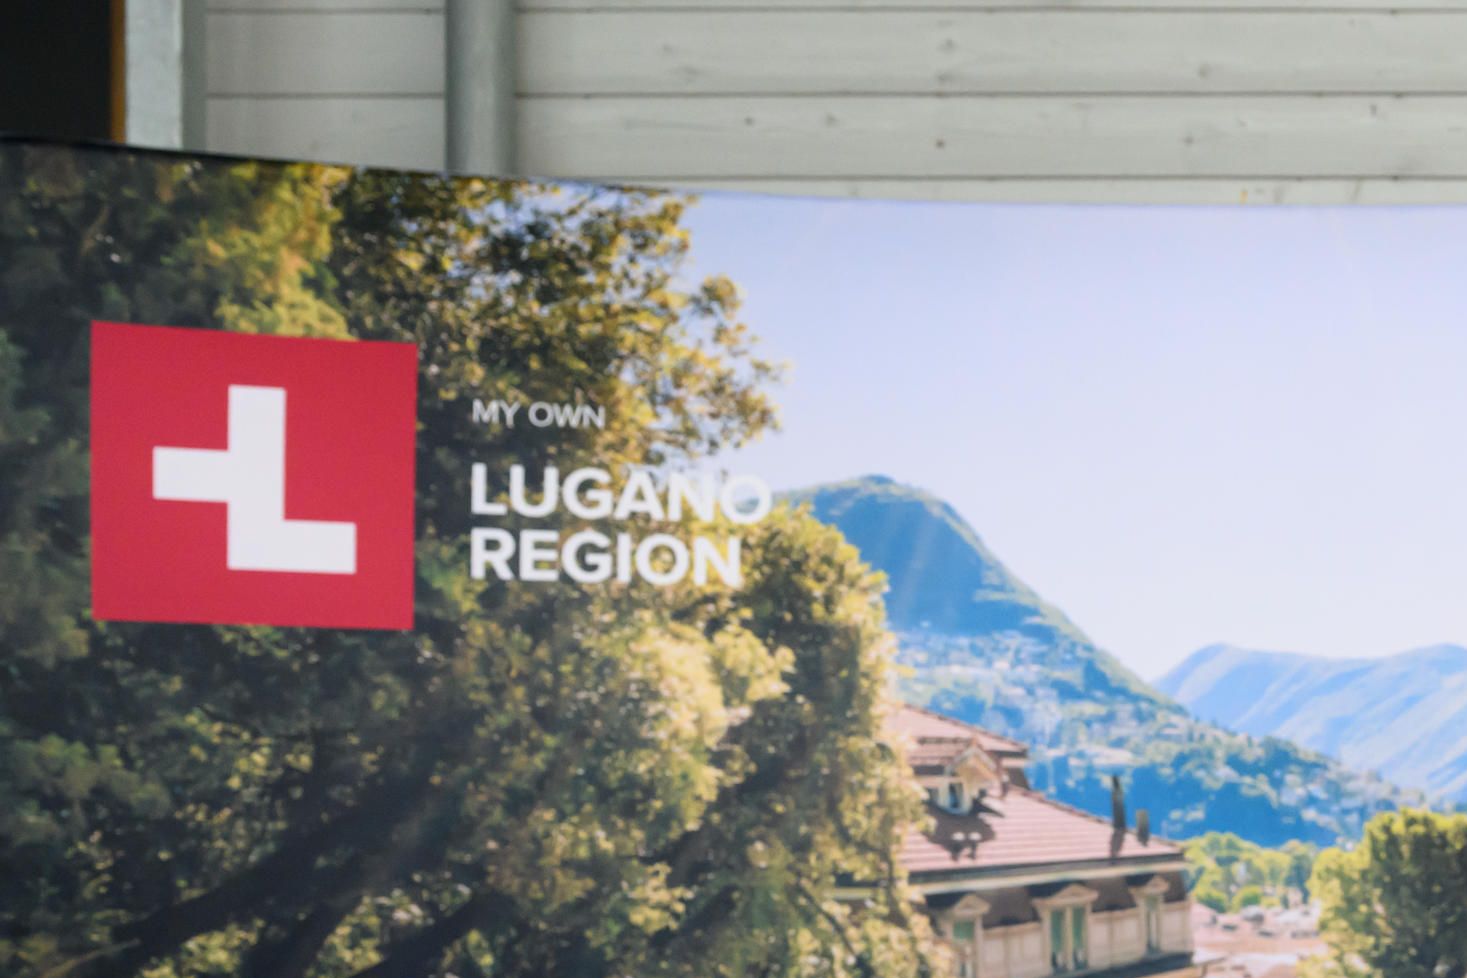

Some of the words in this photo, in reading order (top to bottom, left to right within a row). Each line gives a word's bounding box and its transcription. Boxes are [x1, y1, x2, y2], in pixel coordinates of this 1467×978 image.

[472, 398, 520, 428] MY
[528, 401, 606, 430] OWN
[471, 462, 773, 525] LUGANO
[470, 527, 744, 588] REGION
